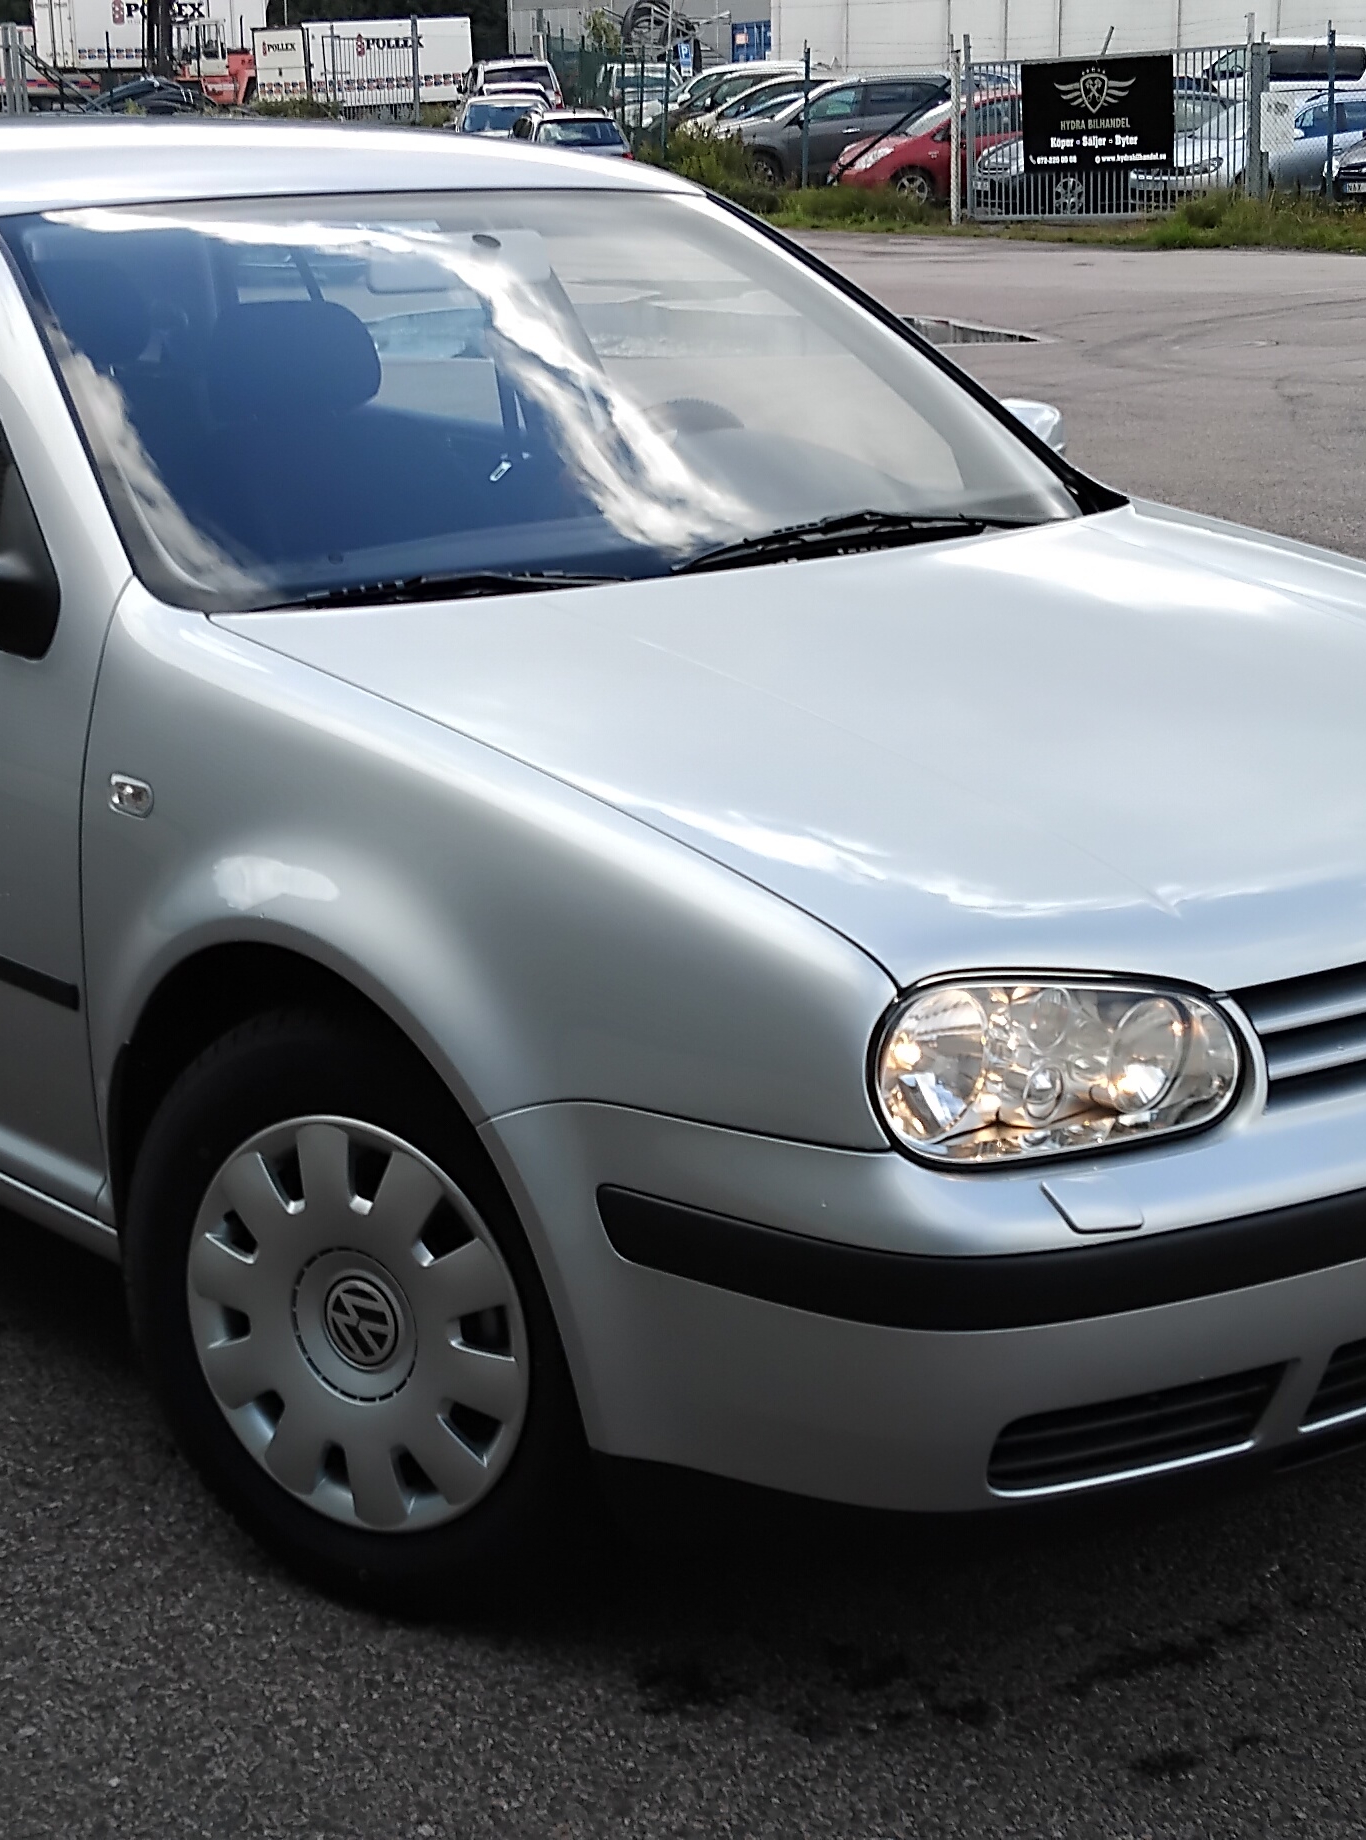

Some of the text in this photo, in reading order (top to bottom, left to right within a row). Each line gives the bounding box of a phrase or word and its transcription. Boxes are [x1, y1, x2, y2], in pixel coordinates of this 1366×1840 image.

[126, 3, 205, 18] POEX
[267, 43, 296, 52] POLLEX
[1060, 117, 1131, 131] HYDRA BILHANDEL
[1050, 134, 1138, 150] Köper Säljer Byter
